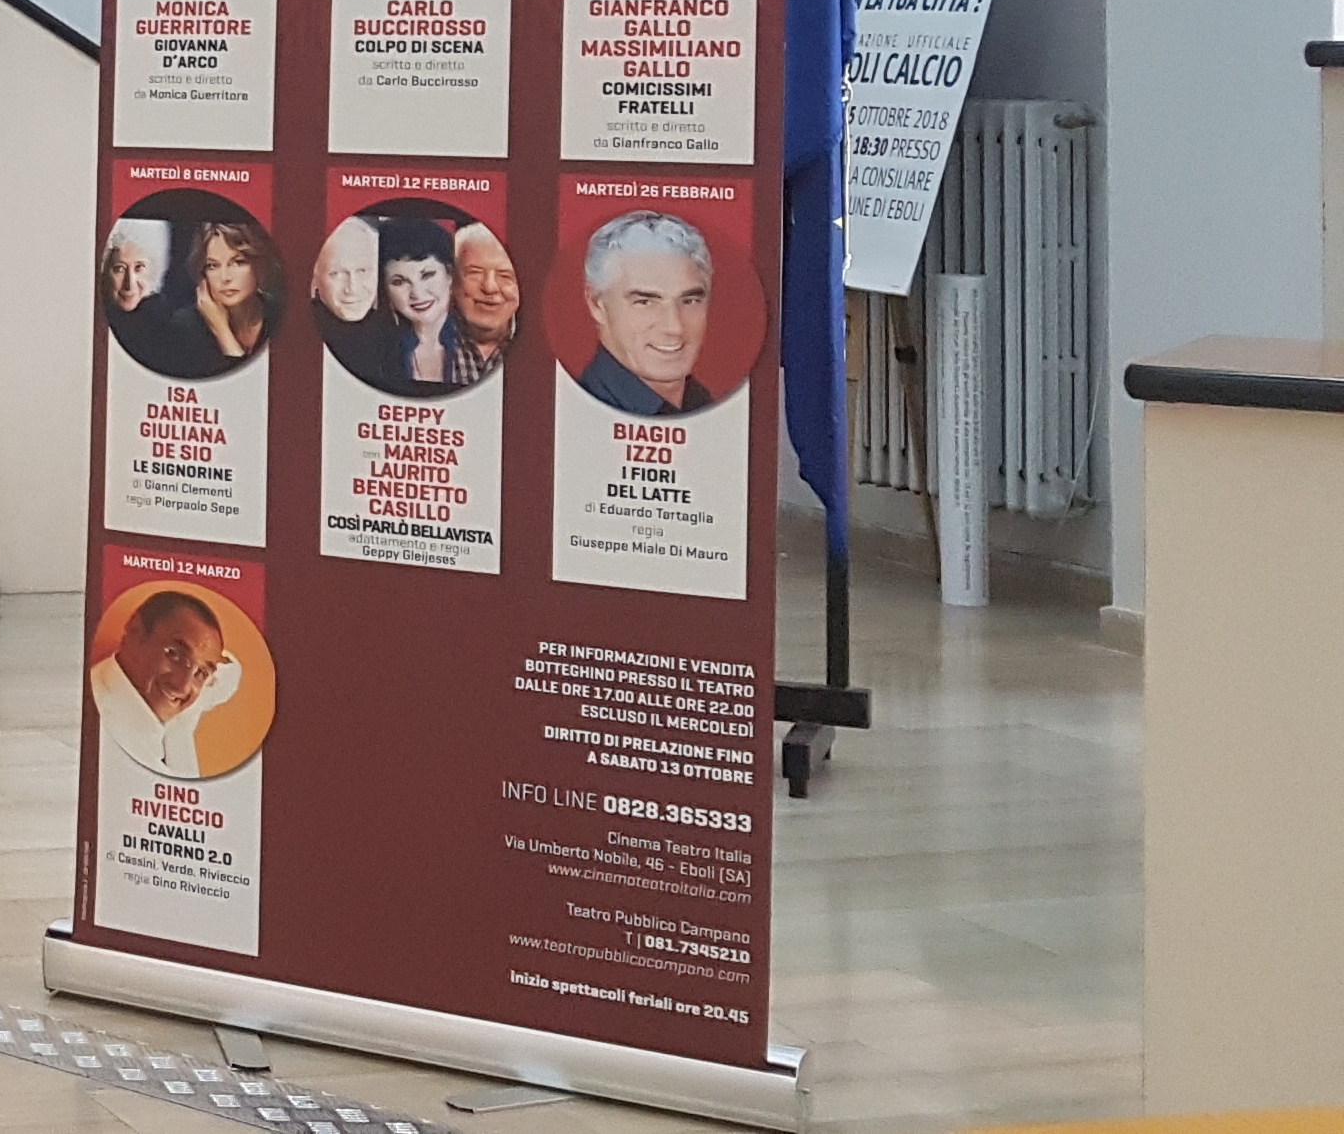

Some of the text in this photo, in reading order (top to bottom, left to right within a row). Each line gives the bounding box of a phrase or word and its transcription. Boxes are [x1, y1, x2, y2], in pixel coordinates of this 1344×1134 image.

[156, 1, 229, 16] MONICA
[387, 0, 453, 16] CARLO
[589, 0, 729, 16] GIANFRANCO
[136, 20, 252, 35] GUERRITORE
[354, 20, 486, 36] BUCCIROSSO
[625, 20, 691, 36] GALLO
[154, 40, 228, 51] GIOVANNA
[355, 41, 484, 54] COLPO DI SCENA
[581, 40, 741, 57] MASSIMILIANO
[859, 34, 971, 50] AZIONE UFFICIALE
[624, 61, 690, 77] GALLO
[848, 52, 962, 87] OLI CALCIO
[376, 75, 407, 86] Carlo
[602, 82, 712, 96] COMICISSIMI
[149, 90, 248, 100] Monica Guerritore
[619, 101, 694, 115] FRATELLI
[859, 106, 912, 128] OTTOBRE
[914, 109, 949, 130] 2018
[613, 137, 719, 150] Gianfranco Gallo
[853, 136, 941, 160] 18:30 PRESSO
[194, 170, 249, 182] GENNAIO
[403, 177, 490, 191] 12 FEBBRAIO
[862, 166, 934, 191] CONSILIARE
[641, 185, 734, 200] 26 FEBBRAIO
[848, 196, 925, 221] UNE DI EBOLI
[168, 387, 198, 404] ISA
[147, 404, 219, 424] DANIELI
[378, 405, 445, 425] GEPPY
[140, 422, 226, 444] GIULIANA
[358, 423, 464, 447] GLEIJESES
[613, 423, 686, 444] BIAGIO
[153, 442, 211, 462] DE SIO
[385, 444, 458, 465] MARISA
[627, 445, 672, 465] IZZO
[134, 460, 233, 481] LE SIGNORINE
[371, 461, 450, 483] LAURITO
[631, 468, 676, 483] FIORI
[145, 480, 178, 492] Gianni
[353, 478, 467, 504] BENEDETTO
[607, 484, 691, 504] DEL LATTE
[155, 497, 207, 511] Pierpaolo
[370, 499, 450, 521] CASILLO
[600, 503, 652, 519] Eduardo
[328, 515, 493, 544] COSÌ PARLÒ BELLAVISTA
[363, 546, 399, 560] Geppy
[570, 535, 728, 561] Giuseppe Mauro
[177, 562, 240, 579] 12 MARZO
[538, 642, 755, 679] PER INFORMAZIONI VENDITA
[525, 659, 754, 698] BOTTEGHINO PRESSO IL TEATRO
[515, 677, 754, 717] DALLE ORE 17.00 ALLE ORE 22.00
[581, 705, 754, 738] ESCLUSO MERCOLEDÌ
[544, 726, 753, 764] DIRITTO DI PRELAZIONE FINO
[600, 753, 753, 785] SABATO 13 OTTOBRE
[155, 783, 199, 805] GINO
[132, 798, 223, 828] RIVIECCIO
[502, 781, 752, 833] INFO LINE 0828.365333
[149, 822, 205, 843] CAVALLI
[123, 834, 232, 866] DI RITORNO 2.0
[505, 835, 715, 879] Via Umberto Eboli
[608, 832, 752, 865] Cinema Teatro Italia
[152, 876, 176, 889] Gino
[567, 903, 750, 944] Teatro Pubblico Campano
[645, 934, 750, 964] 081.7345210
[510, 970, 749, 1024] Inizio spettacoli feriali 20.45
